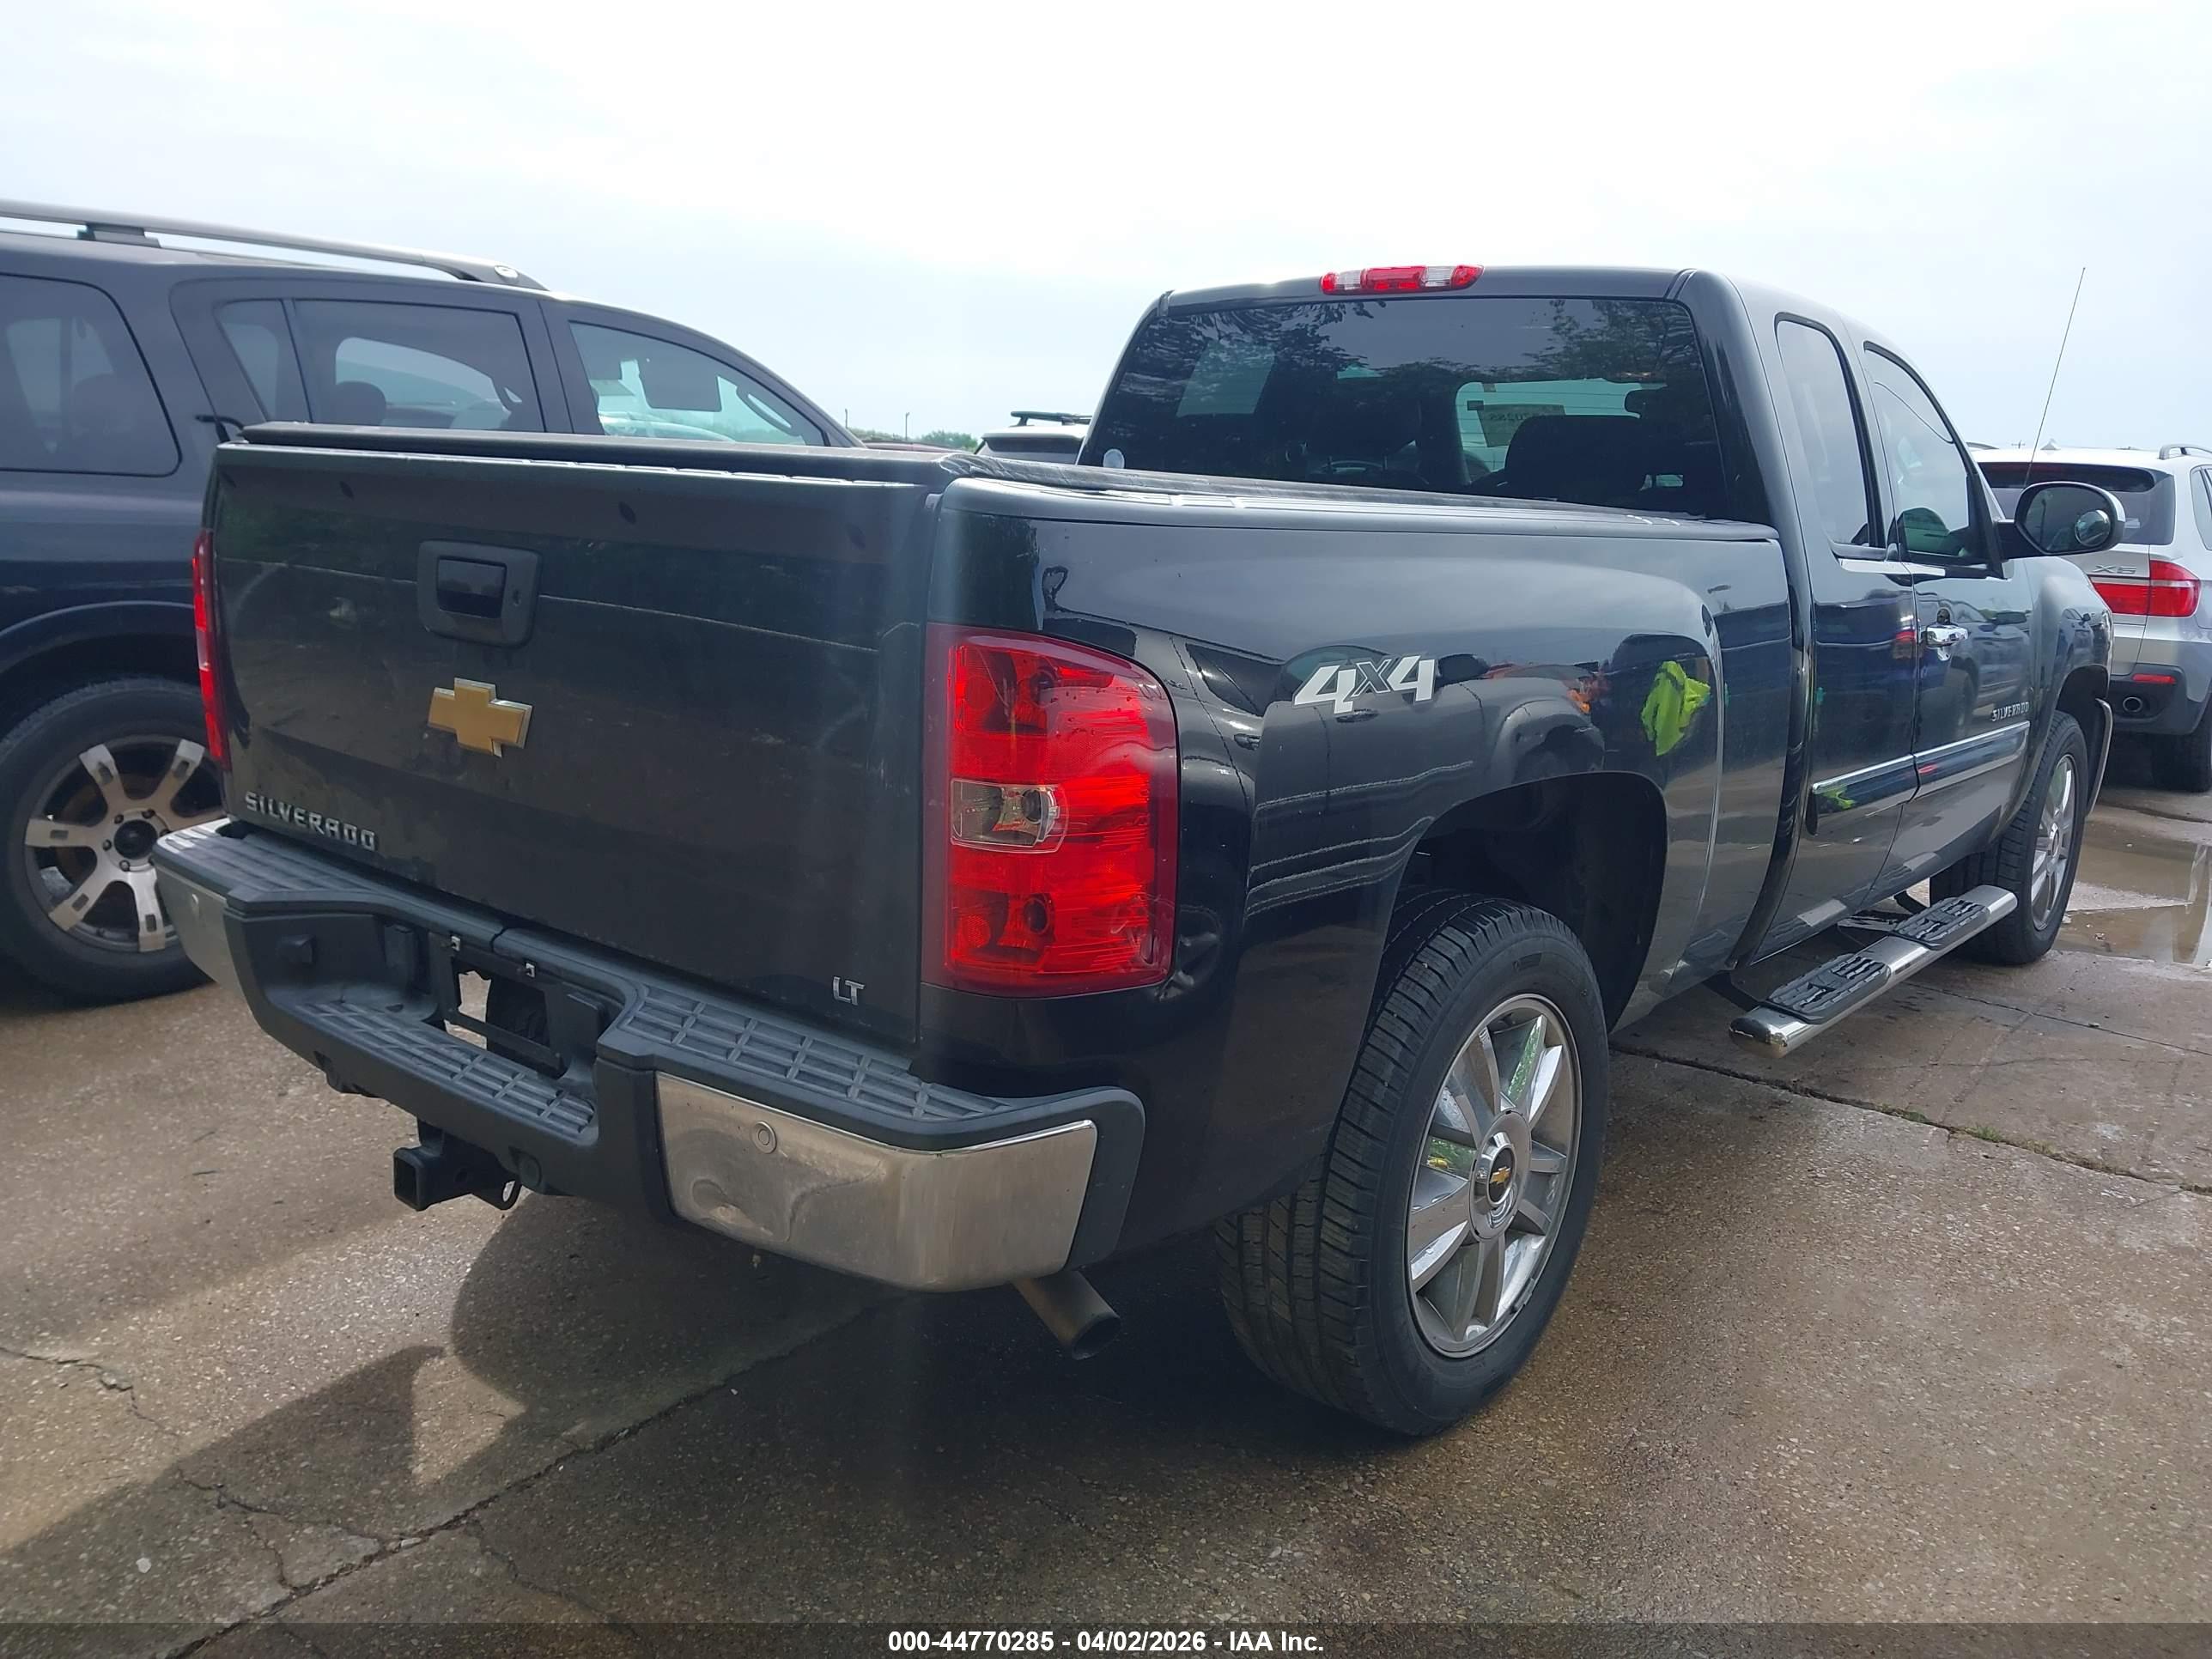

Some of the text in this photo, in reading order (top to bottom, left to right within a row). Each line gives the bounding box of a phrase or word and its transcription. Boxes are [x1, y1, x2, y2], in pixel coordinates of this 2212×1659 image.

[2093, 564, 2137, 574] X5
[1991, 701, 2029, 722] SILVERADO
[245, 791, 375, 851] SILVERADO
[833, 975, 865, 1006] LT
